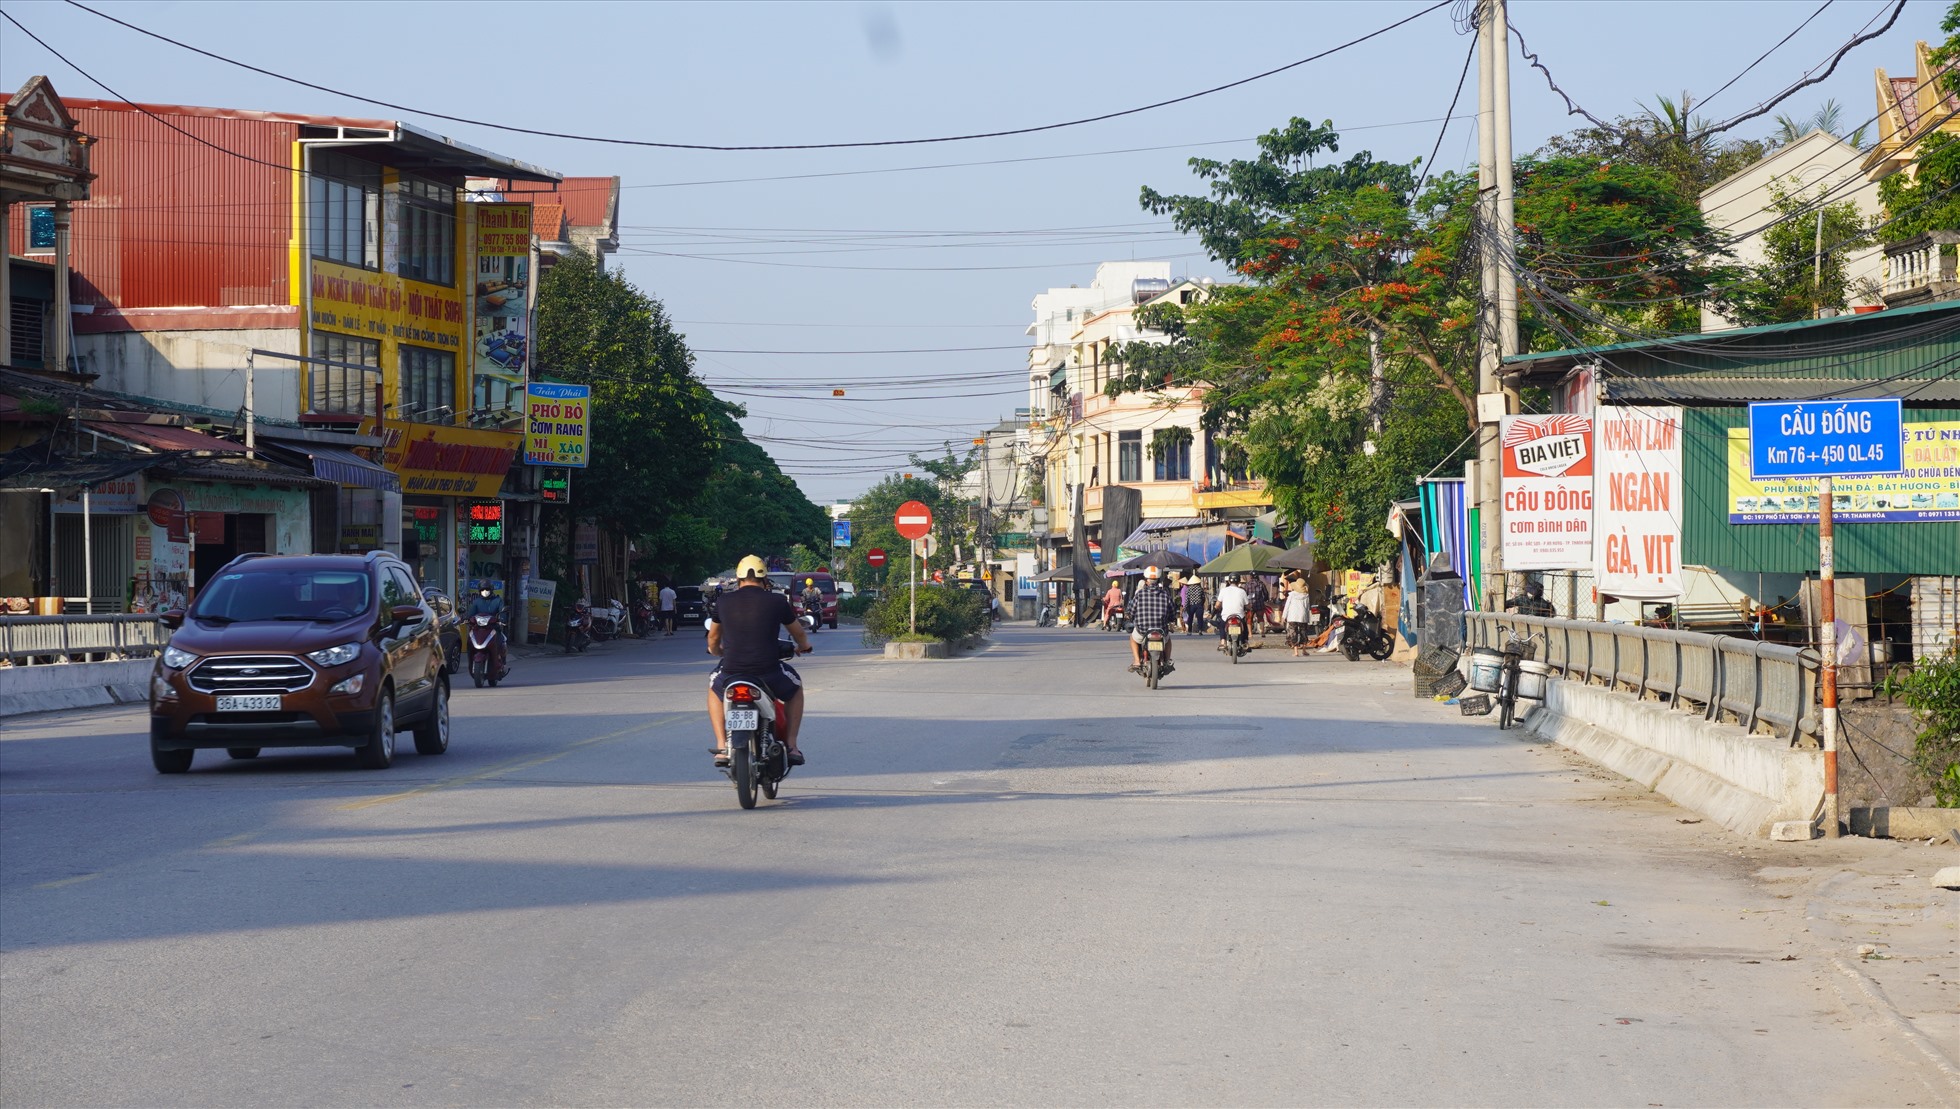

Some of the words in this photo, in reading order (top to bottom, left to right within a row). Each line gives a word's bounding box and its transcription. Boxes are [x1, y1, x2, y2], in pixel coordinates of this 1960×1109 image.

[480, 209, 508, 229] Thanh
[510, 209, 528, 229] Mai
[483, 233, 500, 245] 0977
[501, 233, 514, 245] 755
[515, 233, 528, 245] 886
[313, 265, 325, 298] ẢN
[327, 270, 350, 303] XUẤT
[351, 277, 366, 311] NỘI
[367, 278, 388, 310] THẤT
[389, 281, 401, 313] GỖ
[408, 289, 422, 321] NỘI
[423, 290, 443, 321] THẤT
[444, 299, 463, 324] SOFA
[313, 306, 321, 323] ÁN
[420, 327, 436, 344] CÔNG
[531, 399, 562, 419] PHỞ
[563, 402, 584, 420] BÒ
[1780, 404, 1817, 437] CẦU
[1821, 403, 1872, 435] ĐỐNG
[530, 421, 554, 435] CƠM
[555, 423, 584, 437] RANG
[1603, 412, 1643, 459] NHẬN
[1645, 411, 1676, 451] LÀM
[1914, 427, 1936, 441] TÚ
[533, 436, 548, 449] MÌ
[558, 440, 583, 454] XÀO
[1519, 445, 1547, 465] BIA
[1546, 436, 1582, 460] VIỆT
[528, 448, 555, 462] PHỞ
[1847, 443, 1885, 463] QL.45
[1914, 445, 1932, 462] ĐÁ
[1900, 468, 1916, 480] ẠO
[1917, 465, 1942, 478] CHÙA
[405, 473, 425, 492] NHẬN
[423, 472, 438, 490] LÀM
[437, 478, 454, 491] THEO
[452, 476, 465, 492] YÊU
[1764, 485, 1785, 495] PHỤ
[1787, 483, 1811, 495] KIỆN
[1814, 484, 1853, 493] NÀNH
[1877, 481, 1897, 491] BÁT
[1900, 481, 1941, 491] HƯƠNG
[1504, 484, 1539, 512] CẦU
[1609, 471, 1670, 512] NGAN
[1765, 511, 1778, 520] PHỐ
[1778, 511, 1790, 520] TÂY
[1790, 512, 1803, 520] SƠN
[361, 527, 374, 538] MAI
[1510, 520, 1535, 534] CƠM
[1537, 518, 1563, 533] BÌNH
[1565, 517, 1588, 533] DÂN
[1606, 525, 1639, 579] GÀ,
[1642, 534, 1675, 584] VỊT
[727, 720, 756, 729] 907.06
